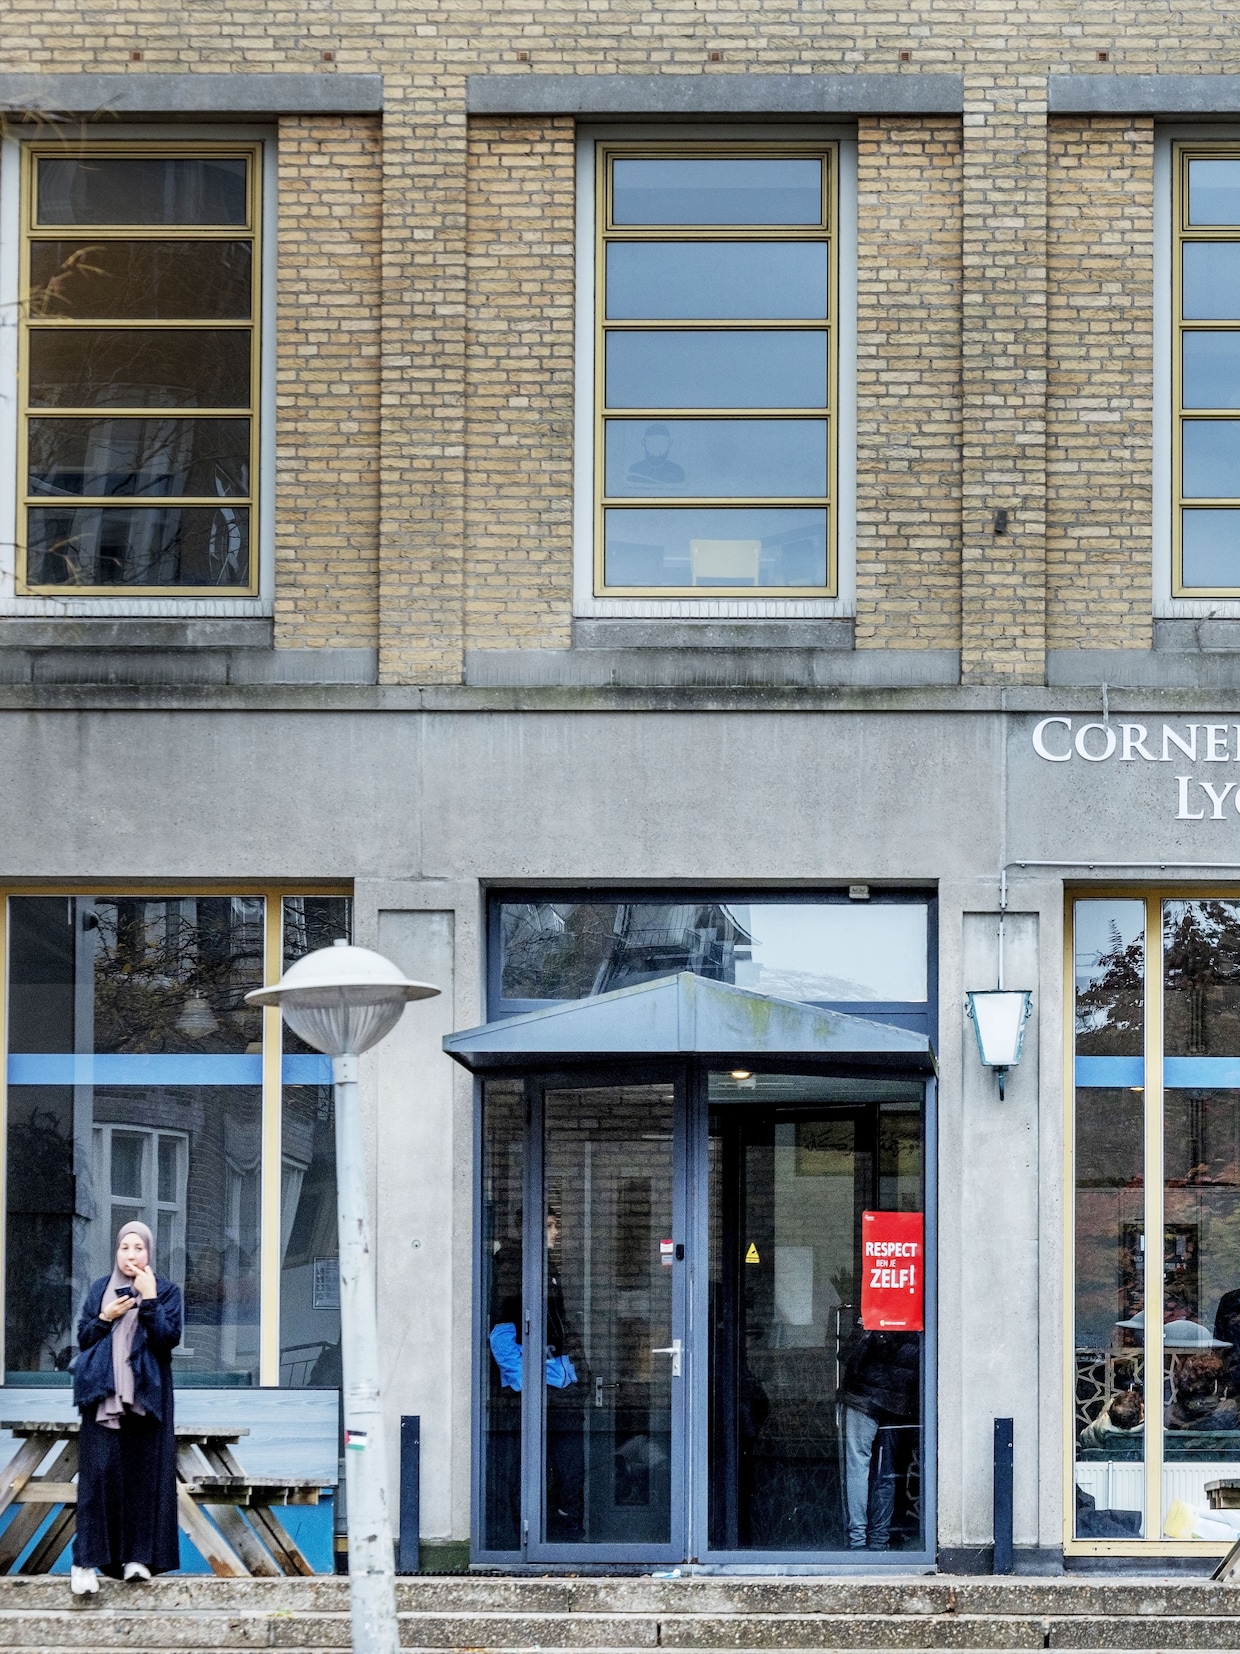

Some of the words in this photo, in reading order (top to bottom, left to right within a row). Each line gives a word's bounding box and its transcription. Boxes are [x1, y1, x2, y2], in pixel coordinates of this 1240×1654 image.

[865, 1241, 918, 1257] RESPECT
[876, 1259, 888, 1267] BEN
[889, 1259, 896, 1267] JE
[870, 1264, 915, 1294] ZELF!
